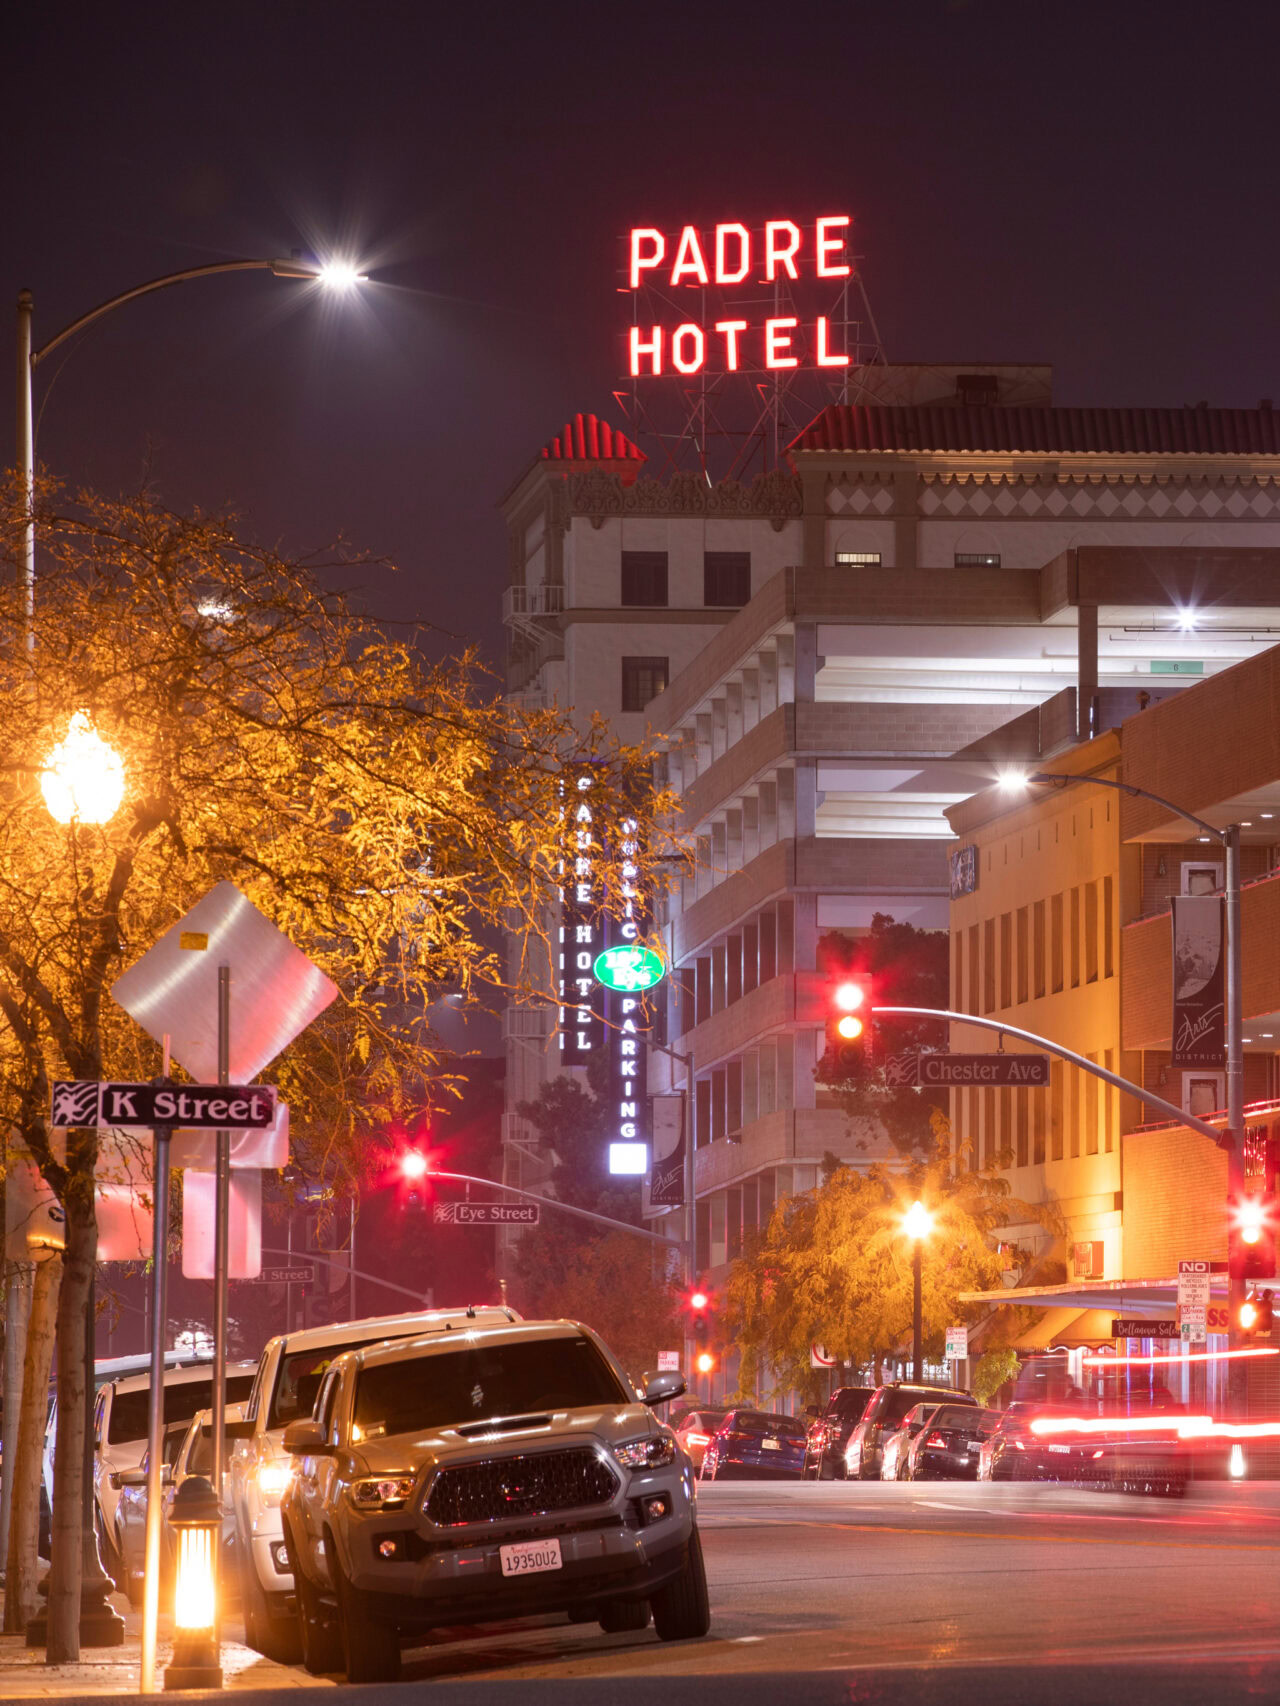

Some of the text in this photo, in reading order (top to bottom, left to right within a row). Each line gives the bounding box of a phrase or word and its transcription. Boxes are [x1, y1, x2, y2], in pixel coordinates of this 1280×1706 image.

[630, 216, 850, 289] PADRE
[630, 316, 850, 376] HOTEL
[576, 925, 593, 1050] HOTEL
[1176, 1002, 1224, 1051] Arts
[1176, 1053, 1223, 1061] DISTRICT
[620, 998, 637, 1138] PARKING
[926, 1060, 1042, 1080] Chester Ave
[110, 1091, 265, 1120] K Street
[459, 1207, 534, 1220] Eye Street
[271, 1270, 310, 1280] Street
[1182, 1263, 1206, 1272] NO
[1117, 1321, 1156, 1336] Bellanova
[506, 1550, 558, 1571] 19350U2
